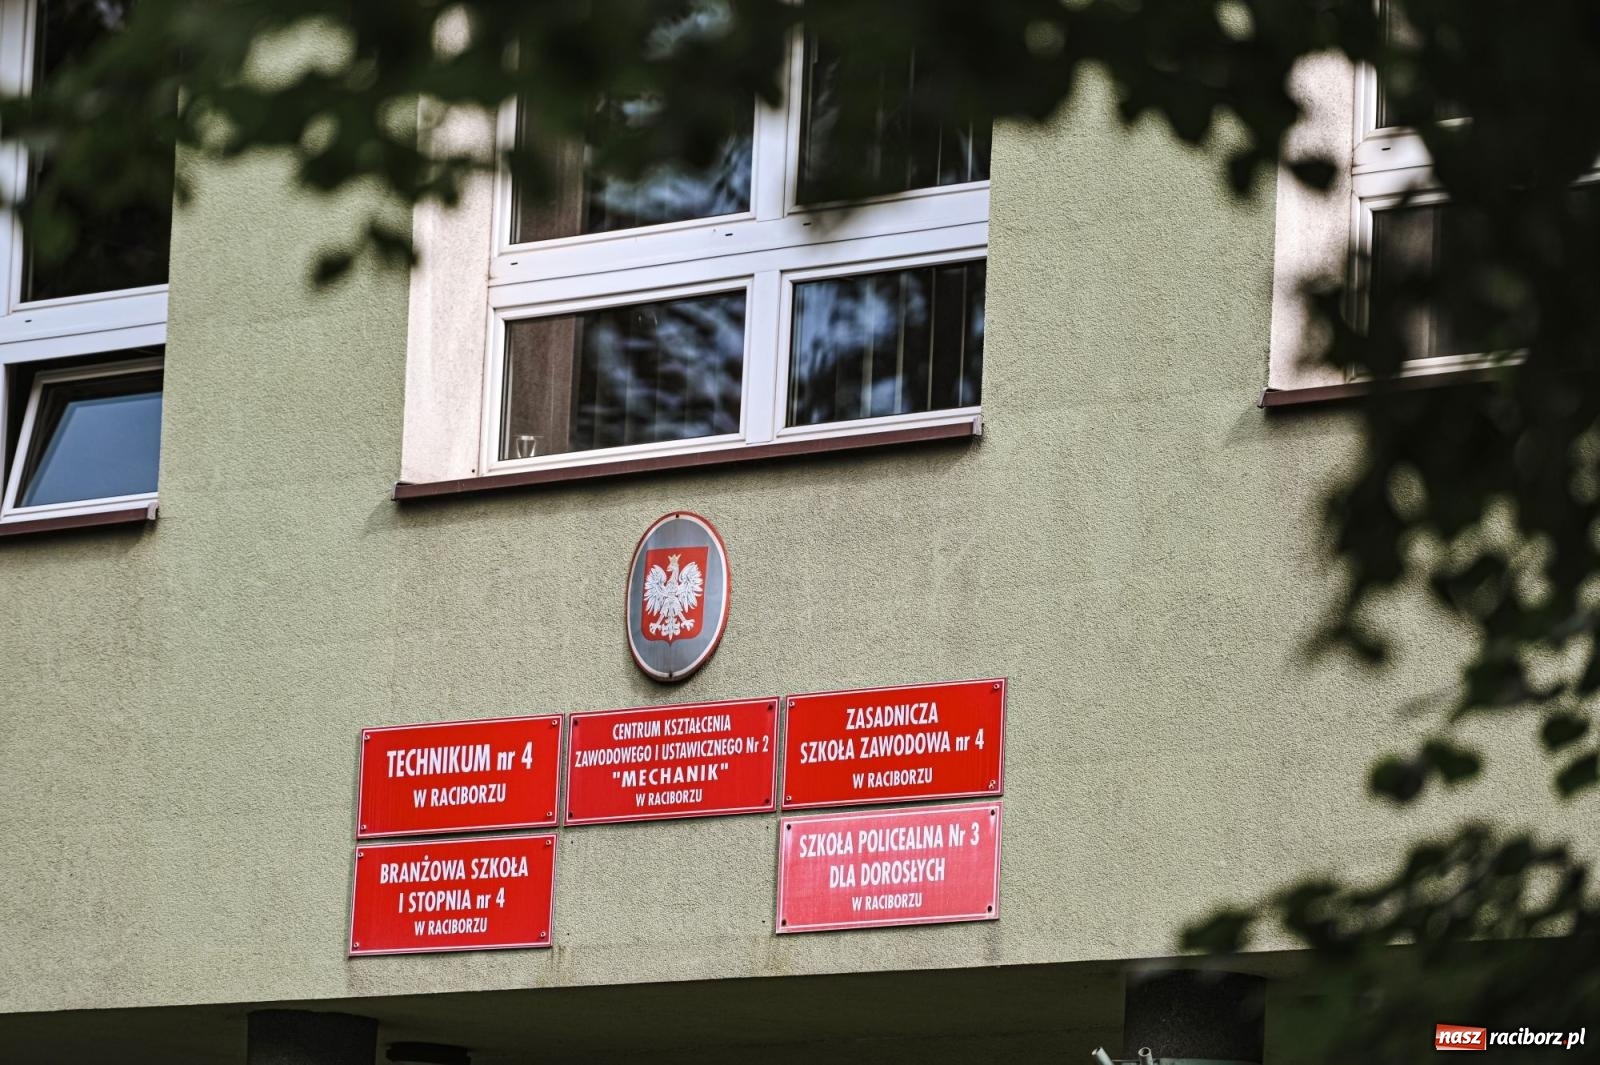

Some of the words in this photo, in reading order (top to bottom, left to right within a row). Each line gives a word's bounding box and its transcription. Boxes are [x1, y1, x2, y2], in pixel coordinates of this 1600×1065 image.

[612, 719, 660, 740] CENTRUM
[665, 714, 731, 736] KSZTAŁCENIA
[846, 702, 938, 730] ZASADNICZA
[575, 745, 651, 768] ZAWODOWEGO
[655, 744, 659, 761] I
[662, 737, 742, 760] USTAWICZNEGO
[746, 739, 759, 754] Nr
[762, 735, 769, 753] 2
[800, 738, 855, 764] SZKOŁA
[860, 731, 950, 759] ZAWODOWA
[955, 735, 970, 751] nr
[975, 728, 984, 750] 4
[387, 744, 491, 778] TECHNIKUM
[497, 751, 515, 770] nr
[521, 742, 533, 769] 4
[612, 763, 729, 788] "MECHANIK"
[853, 773, 864, 789] W
[868, 767, 932, 788] RACIBORZU
[413, 789, 426, 808] W
[431, 783, 506, 807] RACIBORZU
[636, 793, 645, 807] W
[649, 789, 702, 806] RACIBORZU
[800, 831, 853, 858] SZKOŁA
[858, 825, 943, 853] POLICEALNA
[949, 824, 966, 847] Nr
[970, 822, 979, 846] 3
[380, 855, 465, 884] BRANŻOWA
[471, 856, 528, 880] SZKOŁA
[829, 864, 855, 888] DLA
[860, 858, 945, 886] DOROSŁYCH
[399, 893, 403, 913] I
[409, 889, 471, 913] STOPNIA
[476, 894, 491, 909] nr
[496, 887, 505, 908] 4
[852, 896, 863, 911] W
[866, 893, 922, 910] RACIBORZU
[414, 921, 425, 936] W
[428, 917, 487, 935] RACIBORZU
